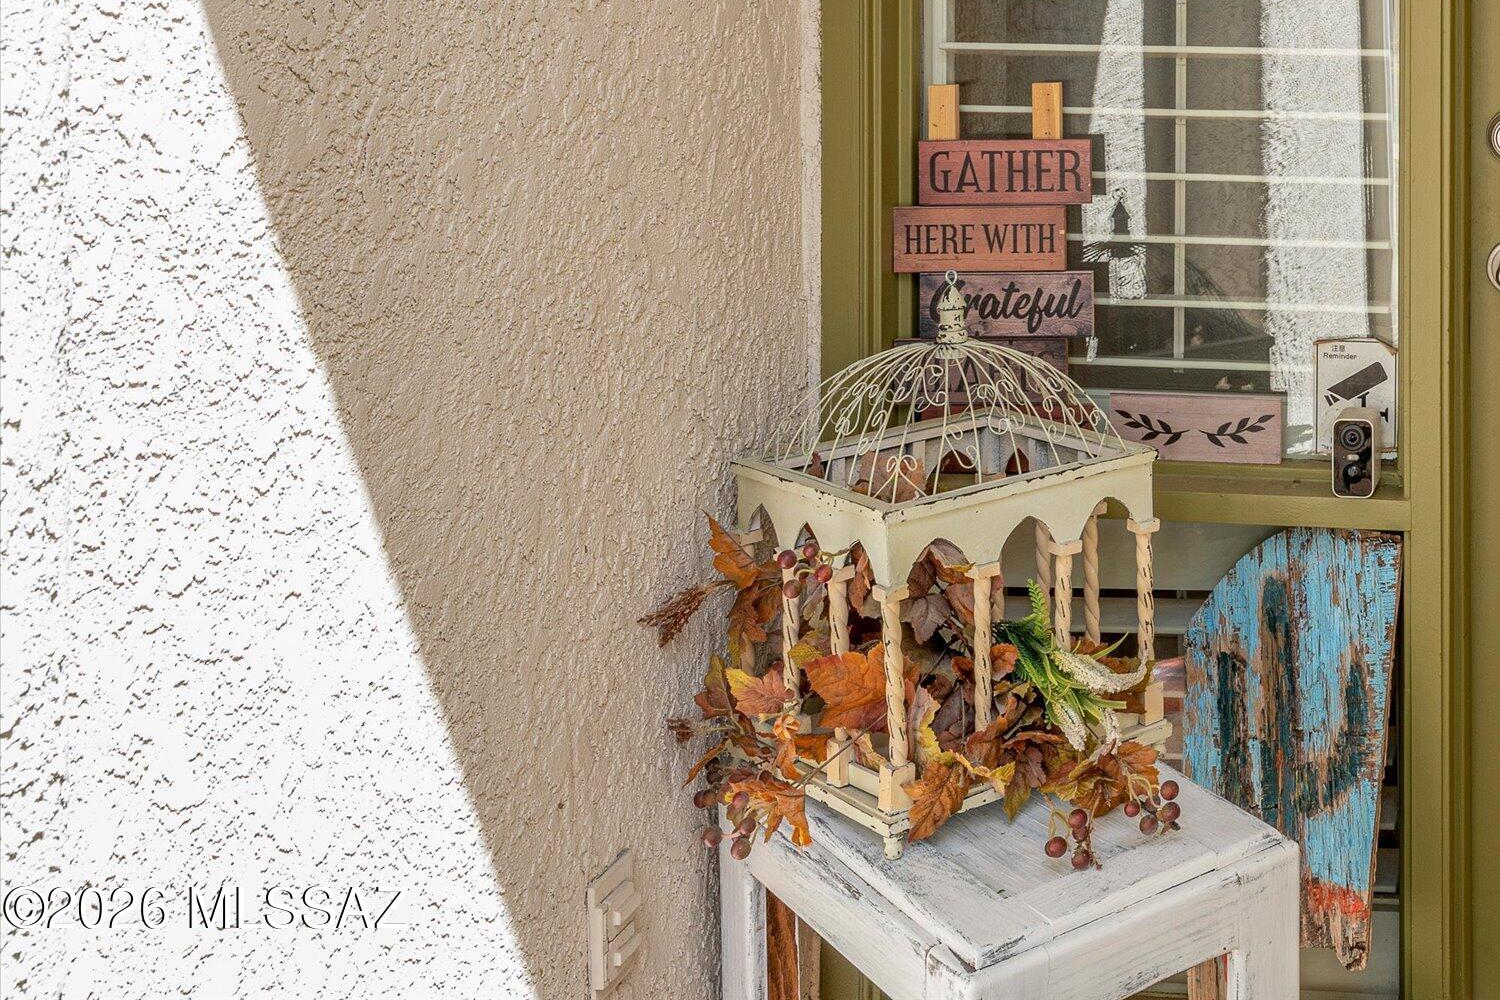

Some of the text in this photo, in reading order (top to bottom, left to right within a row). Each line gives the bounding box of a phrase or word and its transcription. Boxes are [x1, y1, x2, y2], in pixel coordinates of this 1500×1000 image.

[929, 149, 1084, 193] GATHER
[904, 223, 1056, 255] HERE WITH
[1323, 352, 1357, 360] Reminder
